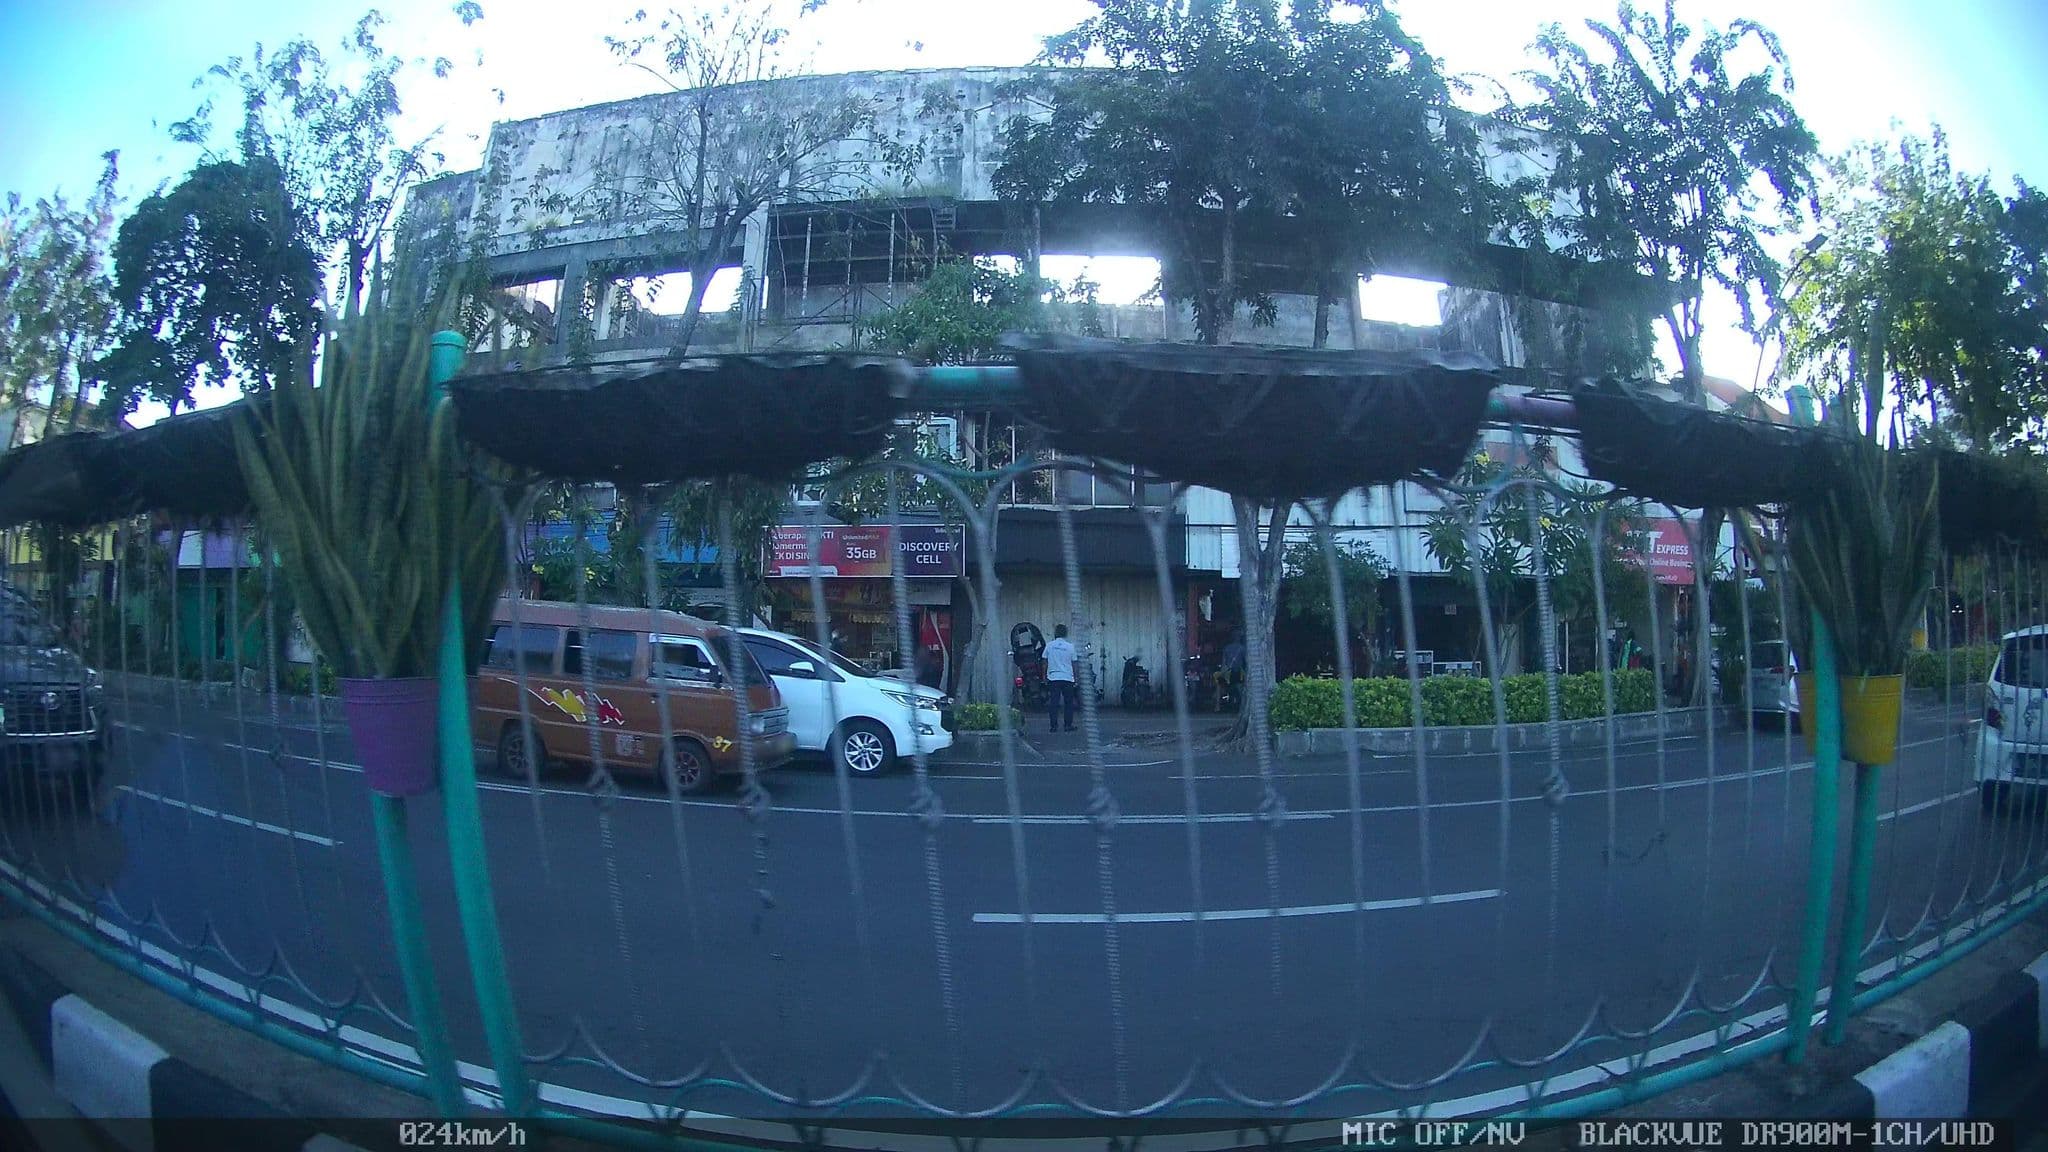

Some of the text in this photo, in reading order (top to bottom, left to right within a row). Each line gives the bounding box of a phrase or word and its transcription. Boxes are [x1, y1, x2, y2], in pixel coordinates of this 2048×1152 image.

[899, 542, 959, 552] DISCOVERY
[1656, 544, 1689, 555] EXPRESS
[795, 551, 811, 560] SIN
[845, 546, 877, 559] 35GB
[915, 554, 942, 564] CELL
[712, 735, 733, 753] 37
